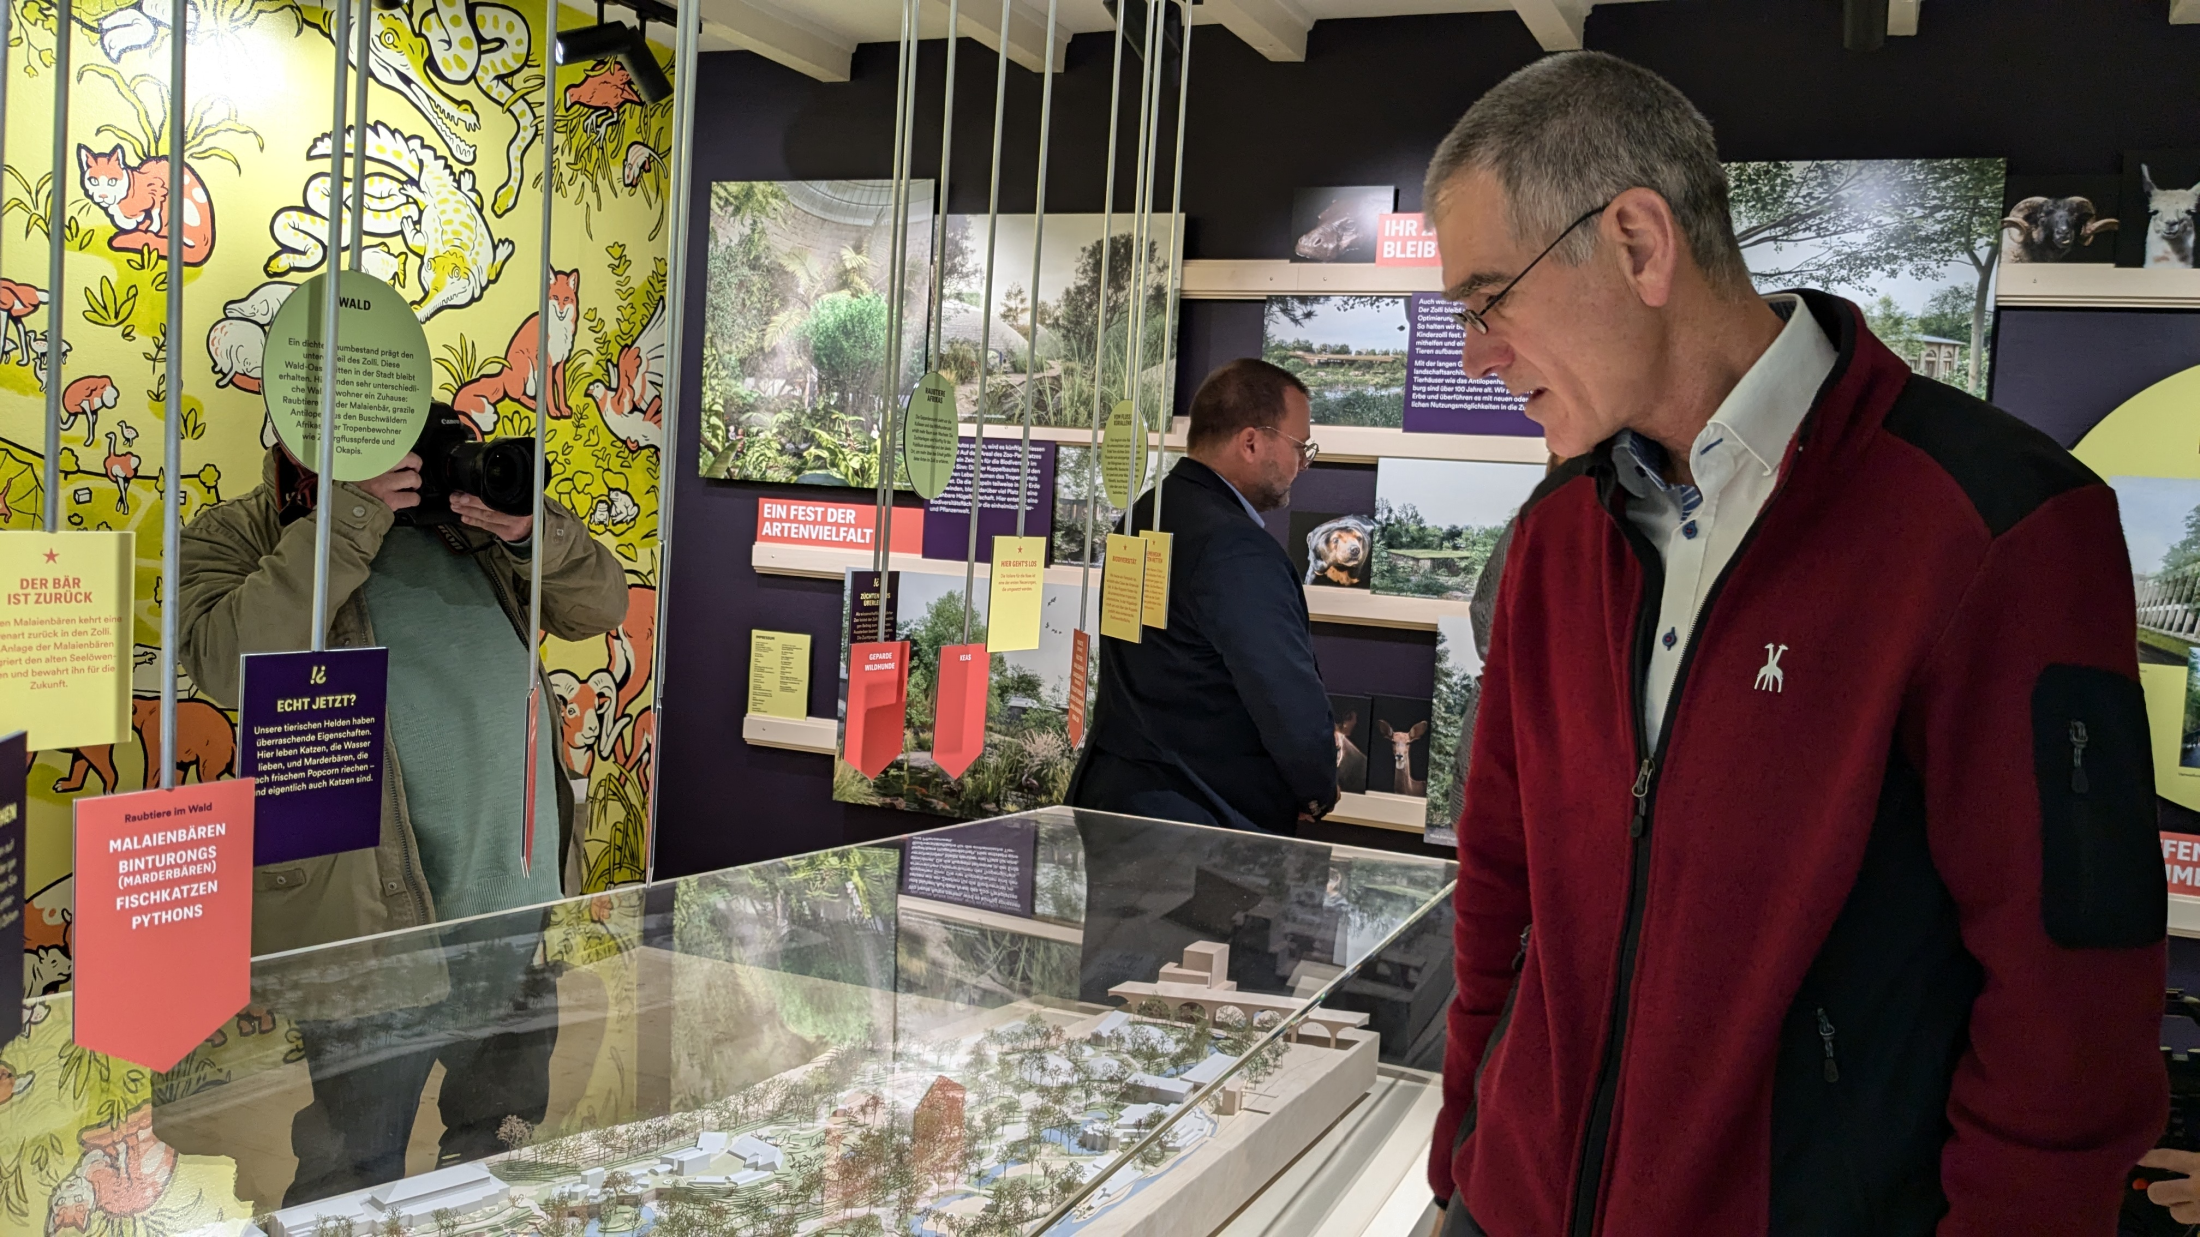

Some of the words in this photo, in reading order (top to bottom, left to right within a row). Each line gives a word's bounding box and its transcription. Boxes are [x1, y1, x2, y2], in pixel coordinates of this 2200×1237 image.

[1384, 220, 1417, 236] IHR
[339, 297, 371, 311] WALD
[288, 338, 300, 347] Ein
[381, 349, 399, 358] prägt
[401, 350, 414, 359] den
[347, 357, 360, 365] des
[362, 358, 379, 367] Zolli.
[381, 359, 400, 369] Diese
[279, 373, 311, 383] erhalten.
[356, 380, 371, 389] sehr
[373, 381, 420, 392] unterschiedli-
[362, 368, 374, 378] der
[376, 370, 394, 380] Stadt
[396, 371, 415, 381] bleibt
[291, 385, 305, 394] che
[364, 391, 375, 400] ein
[377, 393, 408, 403] Zuhause:
[283, 396, 318, 406] Raubtiere
[336, 400, 348, 408] der
[350, 401, 391, 413] Malaienbär,
[392, 405, 414, 415] grazile
[1430, 402, 1500, 410] Nutzungsmöglichkeiten
[359, 413, 407, 424] Buschwäldern
[342, 423, 401, 434] Tropenbewohner
[382, 437, 395, 446] und
[336, 447, 362, 455] Okapis.
[763, 503, 787, 519] EIN
[790, 505, 824, 522] FEST
[827, 507, 856, 524] DER
[762, 522, 873, 543] ARTENVIELFALT
[20, 578, 48, 590] DER
[53, 575, 81, 589] BÄR
[7, 593, 30, 605] IST
[34, 591, 93, 604] ZURÜCK
[14, 617, 76, 627] Malaienbären
[78, 616, 102, 625] kehrt
[104, 615, 122, 623] eine
[27, 629, 58, 639] zurück
[72, 628, 88, 636] den
[90, 627, 112, 636] Zolli.
[1, 643, 33, 653] Anlage
[36, 642, 51, 651] der
[54, 640, 114, 650] Malaienbären
[24, 655, 42, 664] den
[44, 654, 67, 663] alten
[69, 652, 117, 662] Seelöwen-
[869, 652, 892, 660] GEPARDE
[11, 669, 29, 678] und
[31, 667, 69, 677] bewahrt
[71, 666, 85, 675] ihn
[87, 665, 99, 674] für
[102, 664, 116, 673] die
[865, 662, 895, 671] WILDHUNDE
[30, 680, 68, 690] Zukunft.
[277, 697, 310, 713] ECHT
[312, 694, 356, 710] JETZT?
[254, 724, 282, 735] Unsere
[284, 721, 322, 732] tierischen
[324, 719, 351, 729] Helden
[352, 716, 375, 725] haben
[256, 733, 316, 747] überraschende
[318, 728, 372, 742] Eigenschaften.
[257, 750, 274, 760] Hier
[276, 748, 298, 757] leben
[299, 745, 328, 755] Katzen,
[330, 742, 342, 752] die
[344, 740, 370, 750] Wasser
[258, 760, 285, 772] lieben,
[287, 758, 302, 768] und
[304, 753, 355, 766] Marderbären,
[356, 751, 368, 760] die
[271, 771, 306, 783] frischem
[307, 768, 339, 780] Popcorn
[341, 764, 368, 774] riechen
[268, 783, 307, 796] eigentlich
[309, 780, 328, 790] auch
[329, 777, 354, 787] Katzen
[356, 774, 373, 784] sind.
[124, 808, 172, 823] Raubtiere
[174, 806, 186, 816] im
[188, 802, 213, 814] Wald
[109, 822, 226, 853] MALAIENBÄREN
[118, 845, 217, 874] BINTURONGS
[118, 860, 217, 890] (MARDERBÄREN)
[116, 880, 218, 911] FISCHKATZEN
[132, 904, 203, 930] PYTHONS
